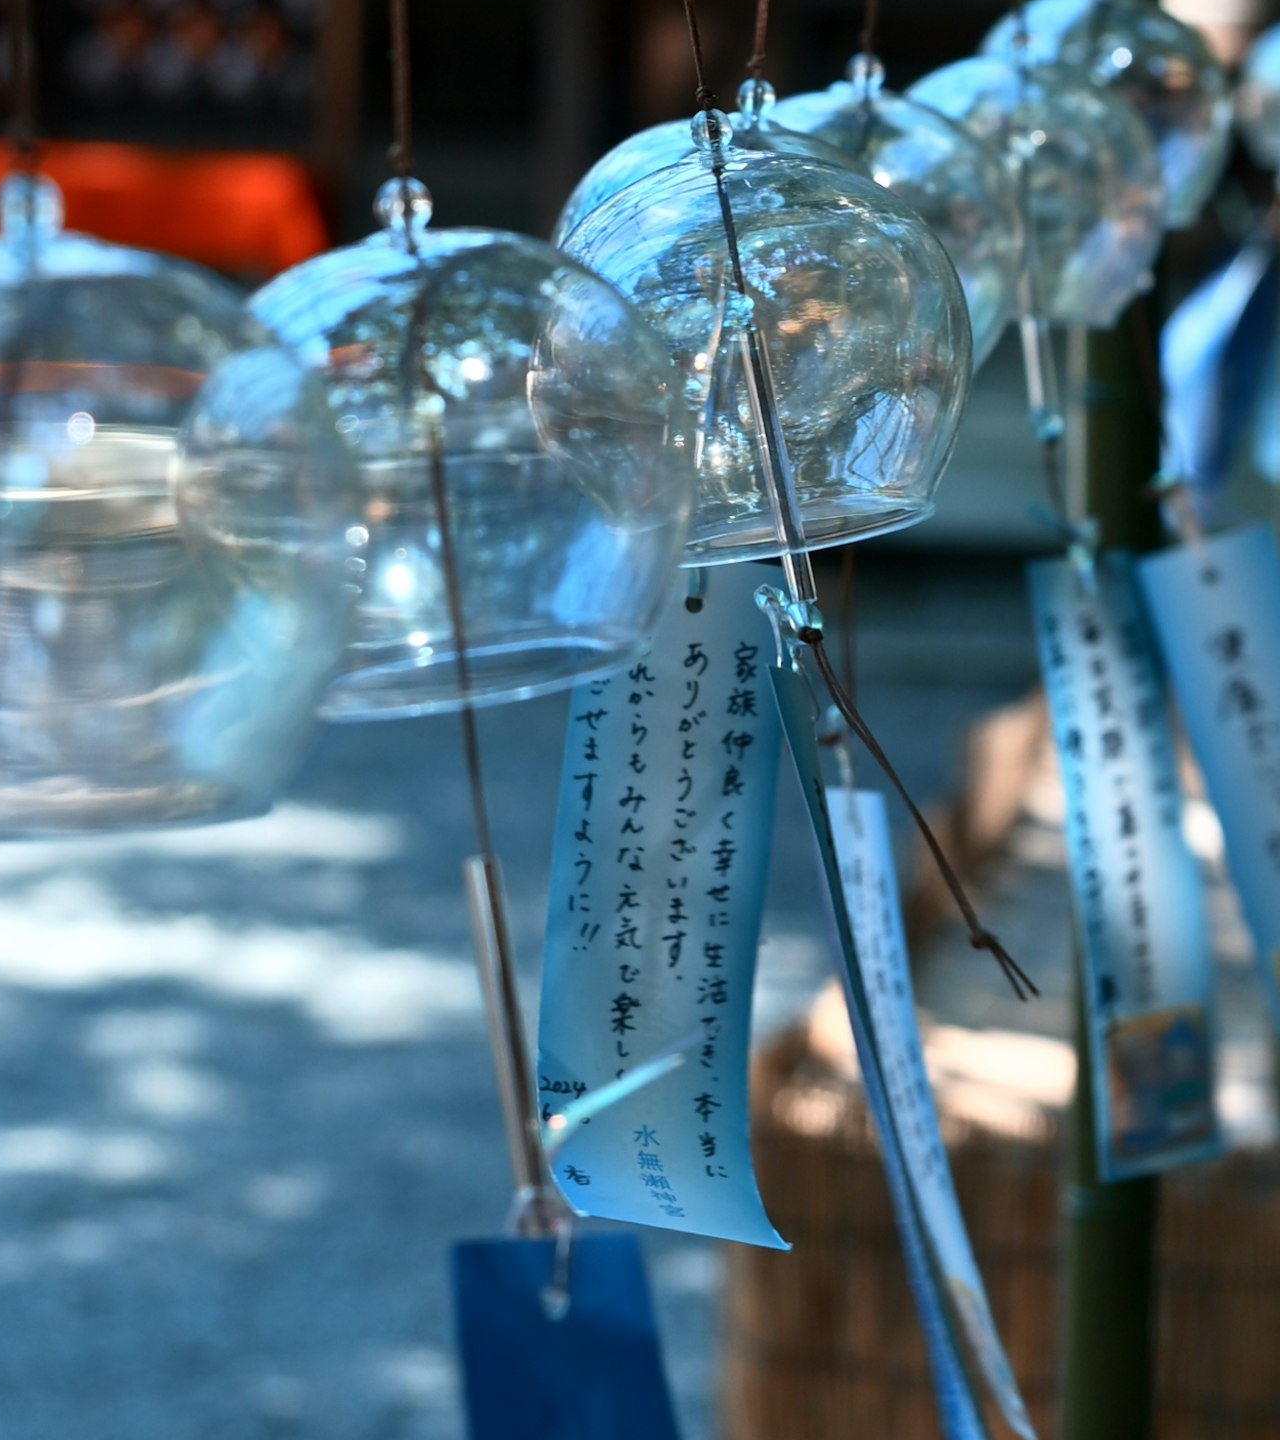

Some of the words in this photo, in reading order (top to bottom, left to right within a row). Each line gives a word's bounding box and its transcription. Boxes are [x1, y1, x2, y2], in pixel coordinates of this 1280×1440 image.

[539, 1075, 587, 1099] 2024
[634, 1123, 686, 1218] 水無瀬神宮
